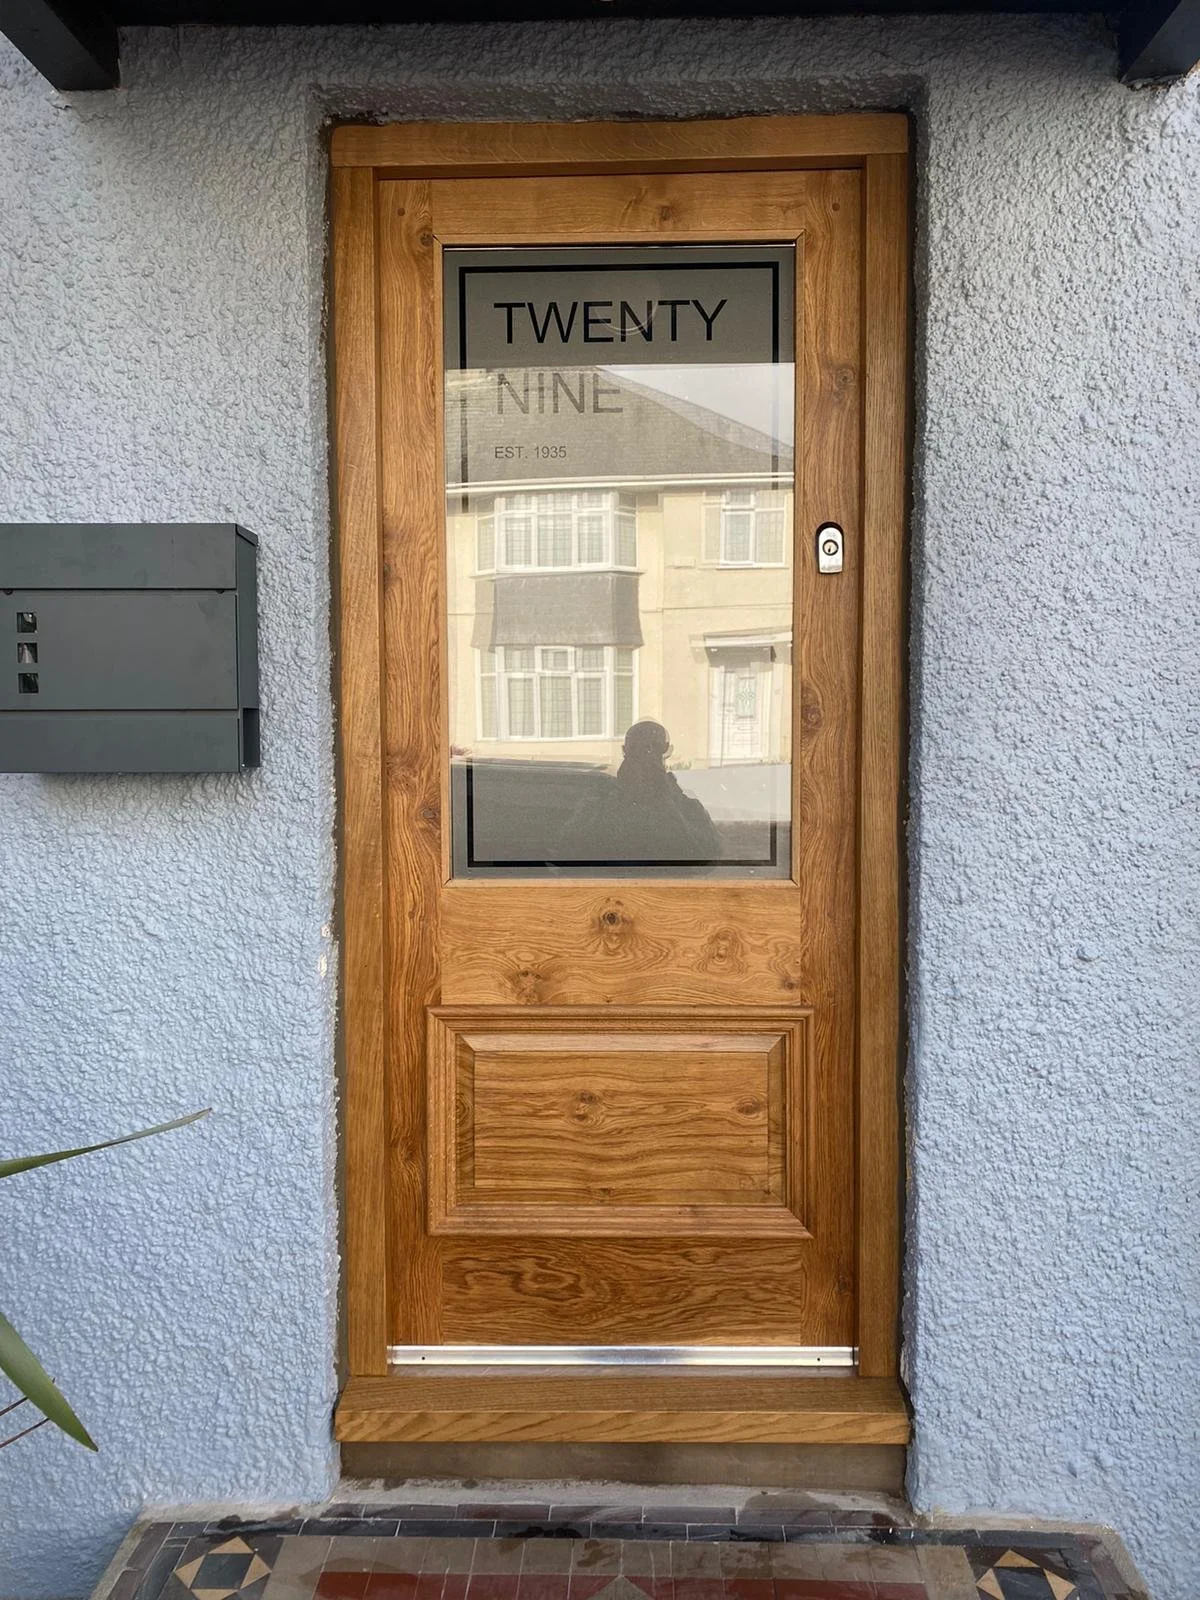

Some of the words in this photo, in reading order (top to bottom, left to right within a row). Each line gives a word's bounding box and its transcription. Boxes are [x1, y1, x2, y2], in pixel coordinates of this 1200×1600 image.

[493, 298, 728, 344] TWENTY
[497, 371, 623, 414] NINE
[494, 445, 528, 459] EST.
[534, 445, 567, 459] 1935
